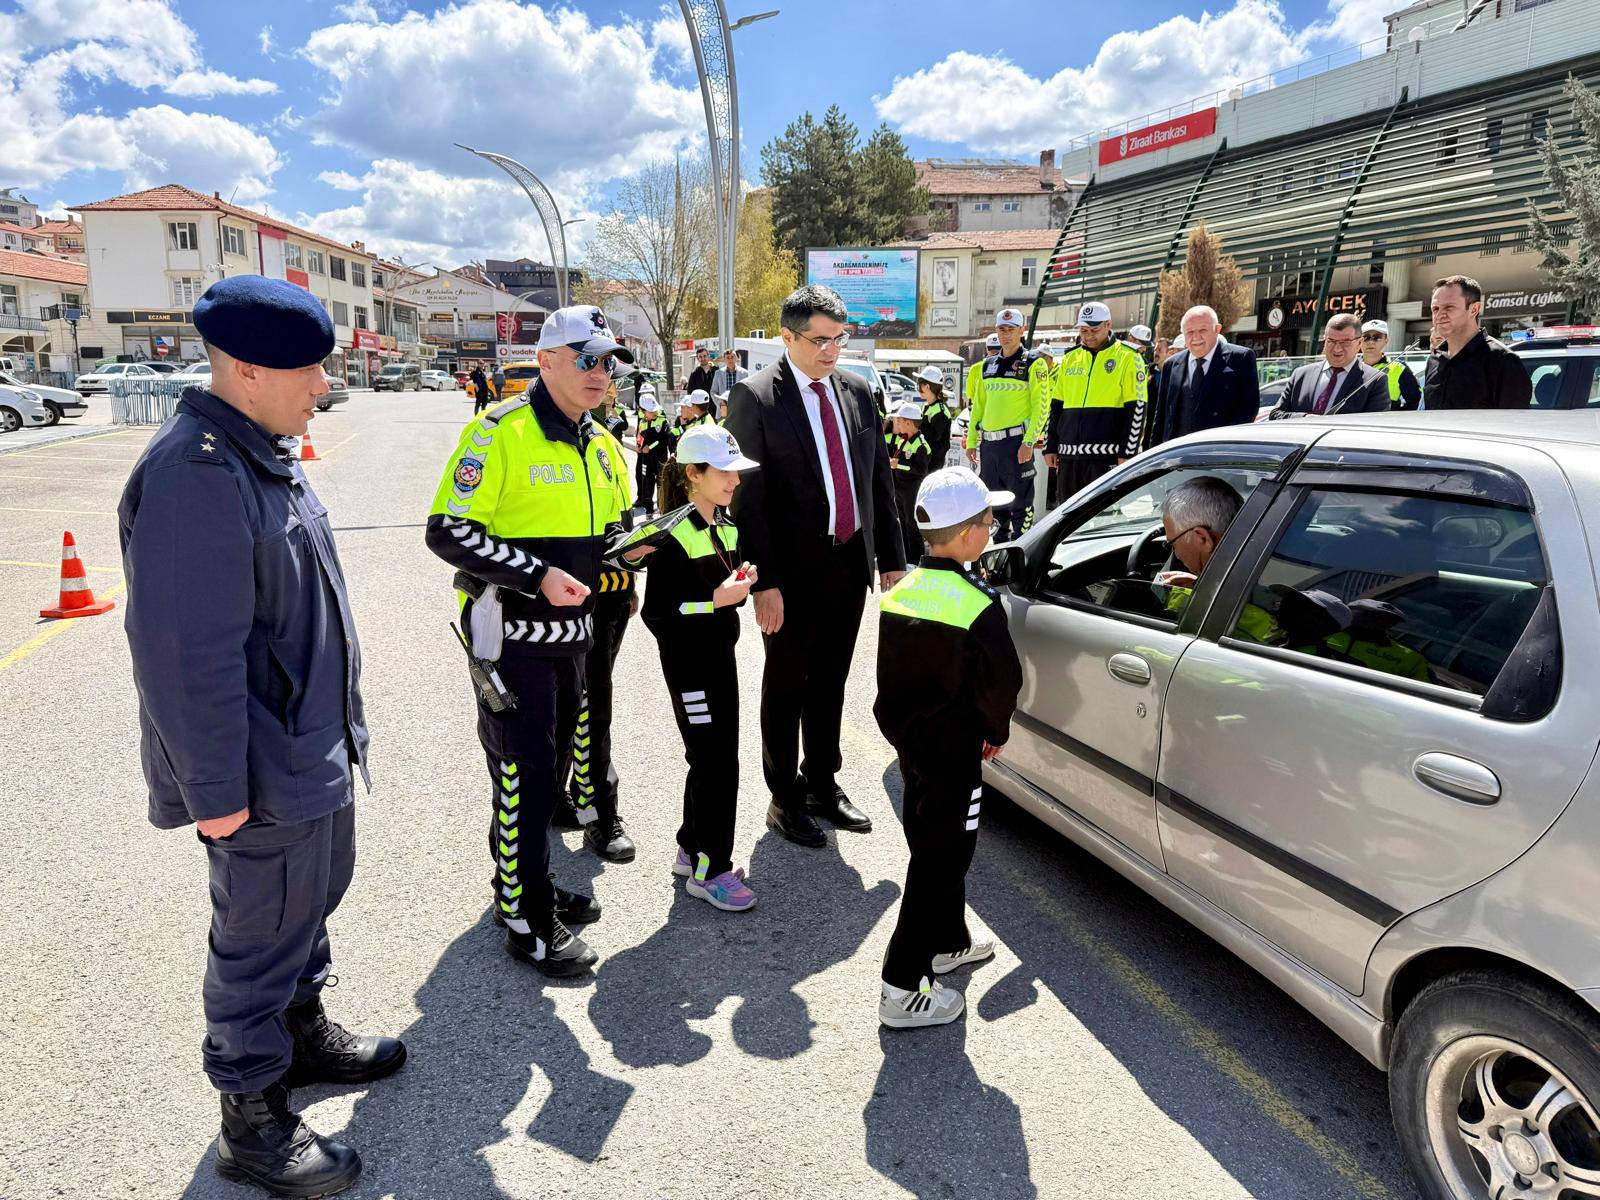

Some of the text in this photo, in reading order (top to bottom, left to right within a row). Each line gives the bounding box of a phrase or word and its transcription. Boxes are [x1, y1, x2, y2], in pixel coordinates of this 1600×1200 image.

[1129, 125, 1187, 151] Ziraat Bankası
[1485, 291, 1566, 309] Samsat Çiğkö
[511, 349, 537, 358] vodafo
[529, 464, 575, 486] POLİS
